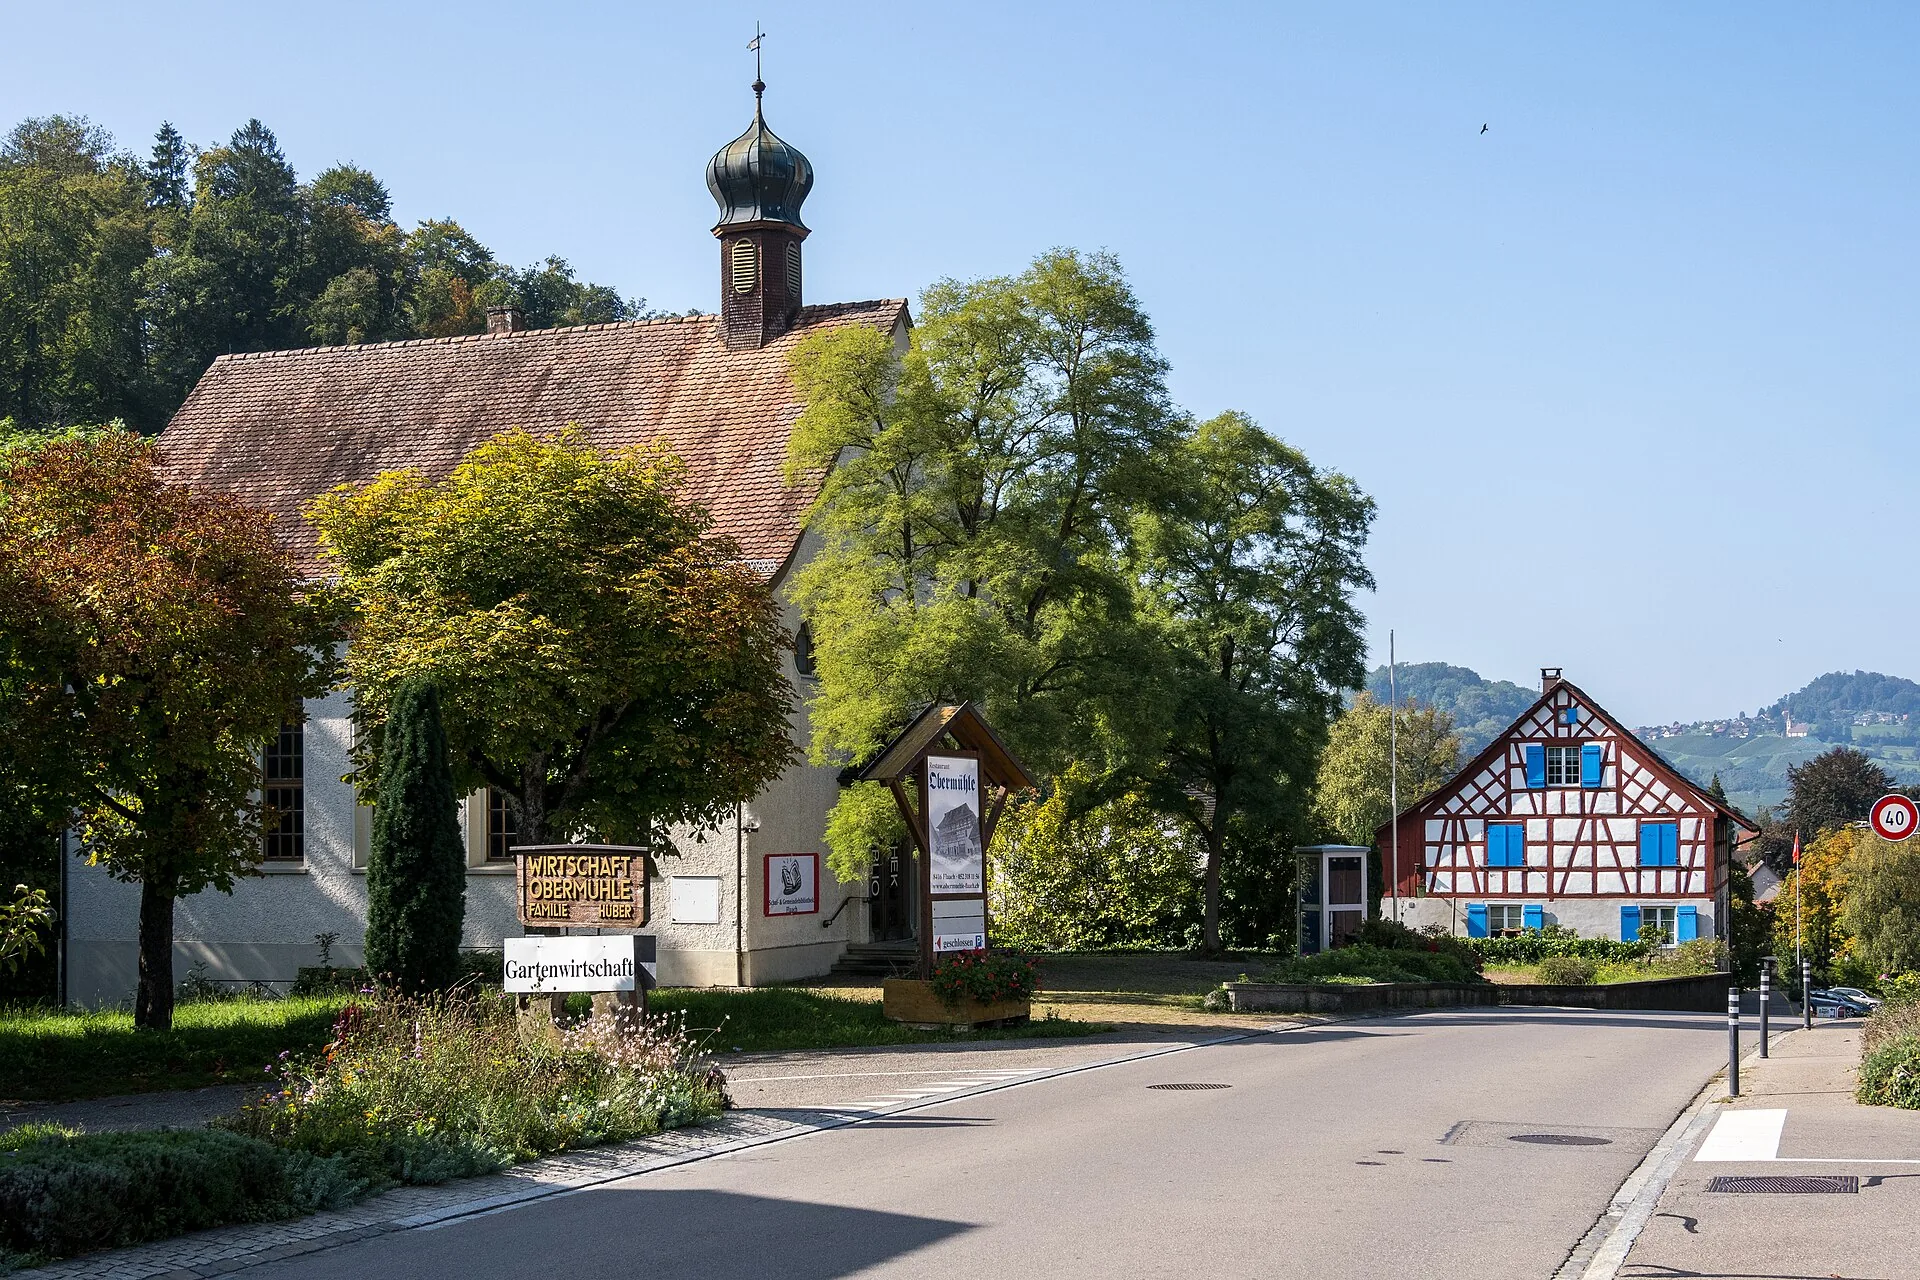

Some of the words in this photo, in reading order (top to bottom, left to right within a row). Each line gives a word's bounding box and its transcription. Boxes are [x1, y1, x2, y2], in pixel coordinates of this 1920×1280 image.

[929, 771, 976, 795] Obermühle
[1885, 810, 1905, 826] 40
[528, 855, 631, 877] WIRTSCHAFT
[528, 902, 569, 918] FAMILIE
[598, 903, 632, 918] HUBER
[943, 937, 974, 949] geschlossen
[505, 957, 634, 980] Gartenwirtschaft
